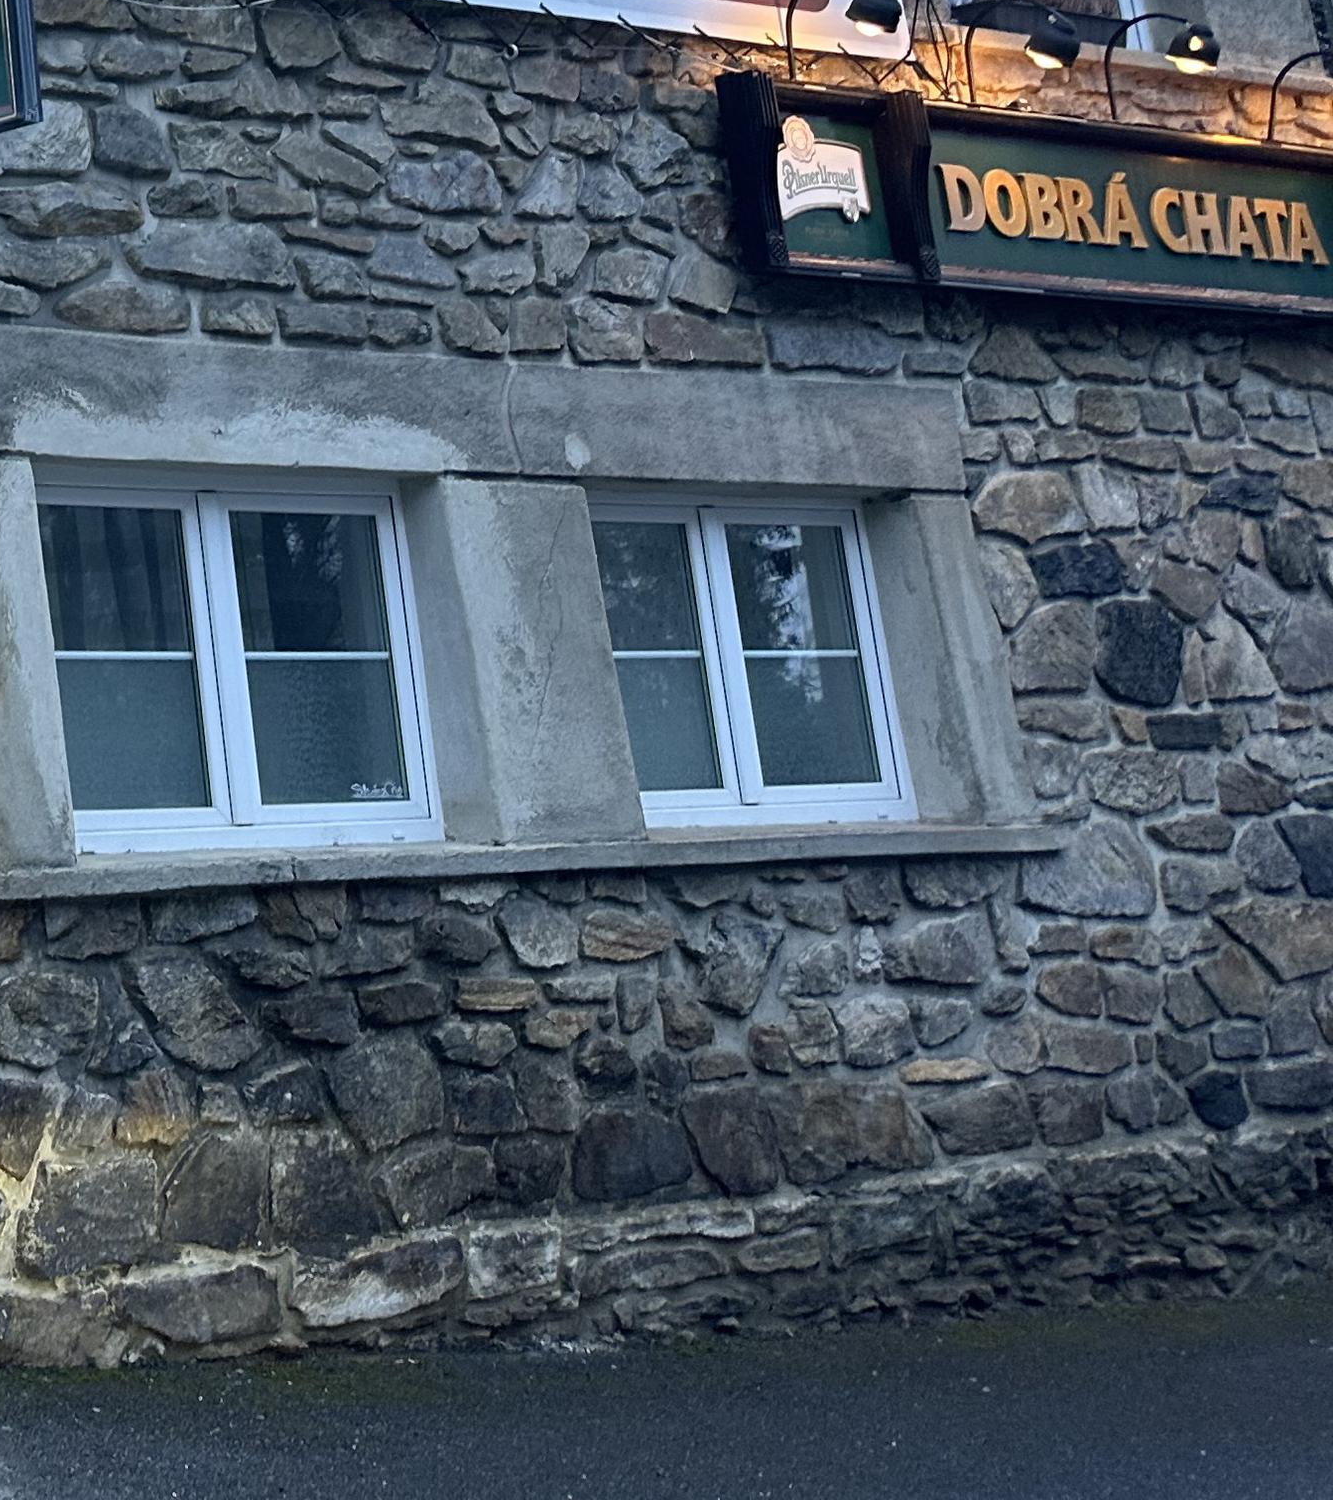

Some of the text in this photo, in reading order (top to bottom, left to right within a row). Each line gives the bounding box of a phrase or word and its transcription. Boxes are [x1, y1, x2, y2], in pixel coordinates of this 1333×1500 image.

[782, 159, 820, 200] Pilsner
[935, 163, 1330, 266] DOBRÁ CHATA
